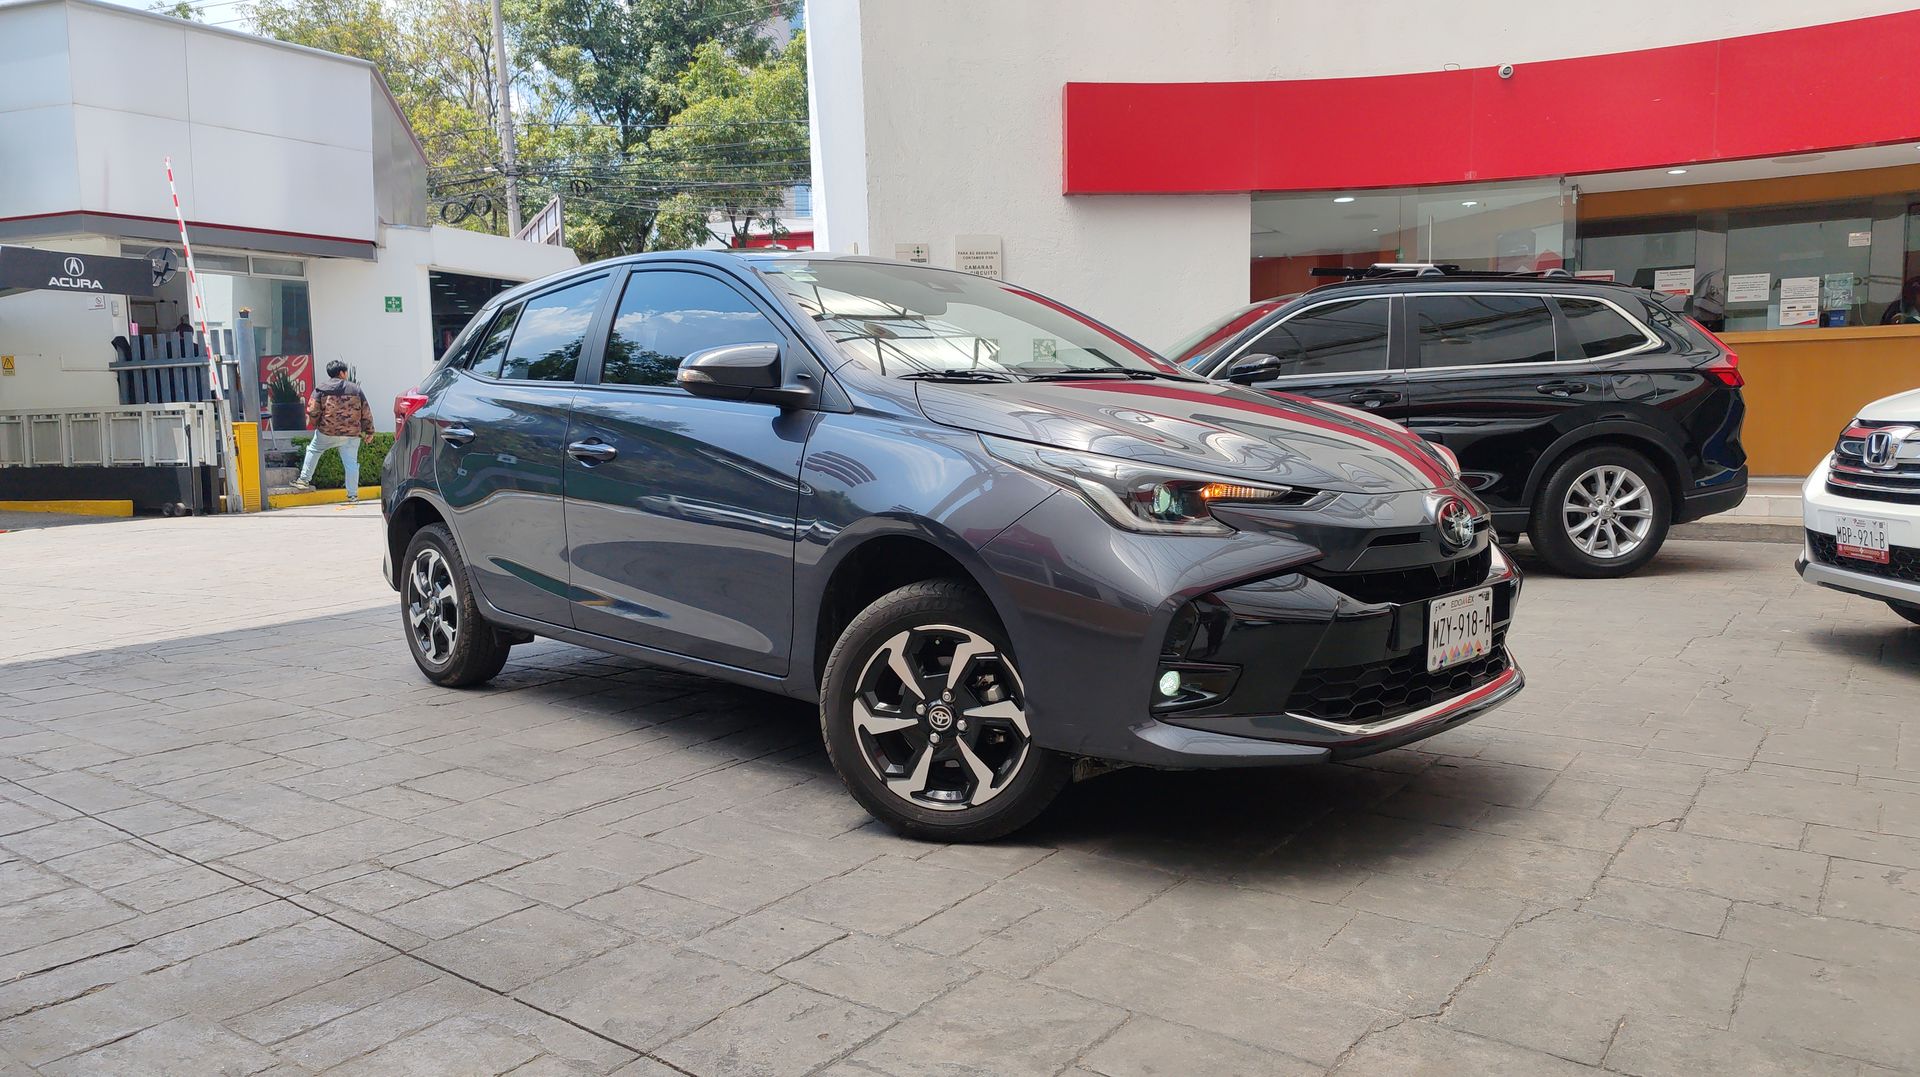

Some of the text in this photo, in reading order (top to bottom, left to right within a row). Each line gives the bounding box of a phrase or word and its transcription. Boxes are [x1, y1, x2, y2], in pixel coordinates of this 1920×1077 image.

[48, 276, 103, 290] ACURA
[1836, 526, 1885, 549] MBP-921-B
[1432, 606, 1490, 650] MZY-918-A
